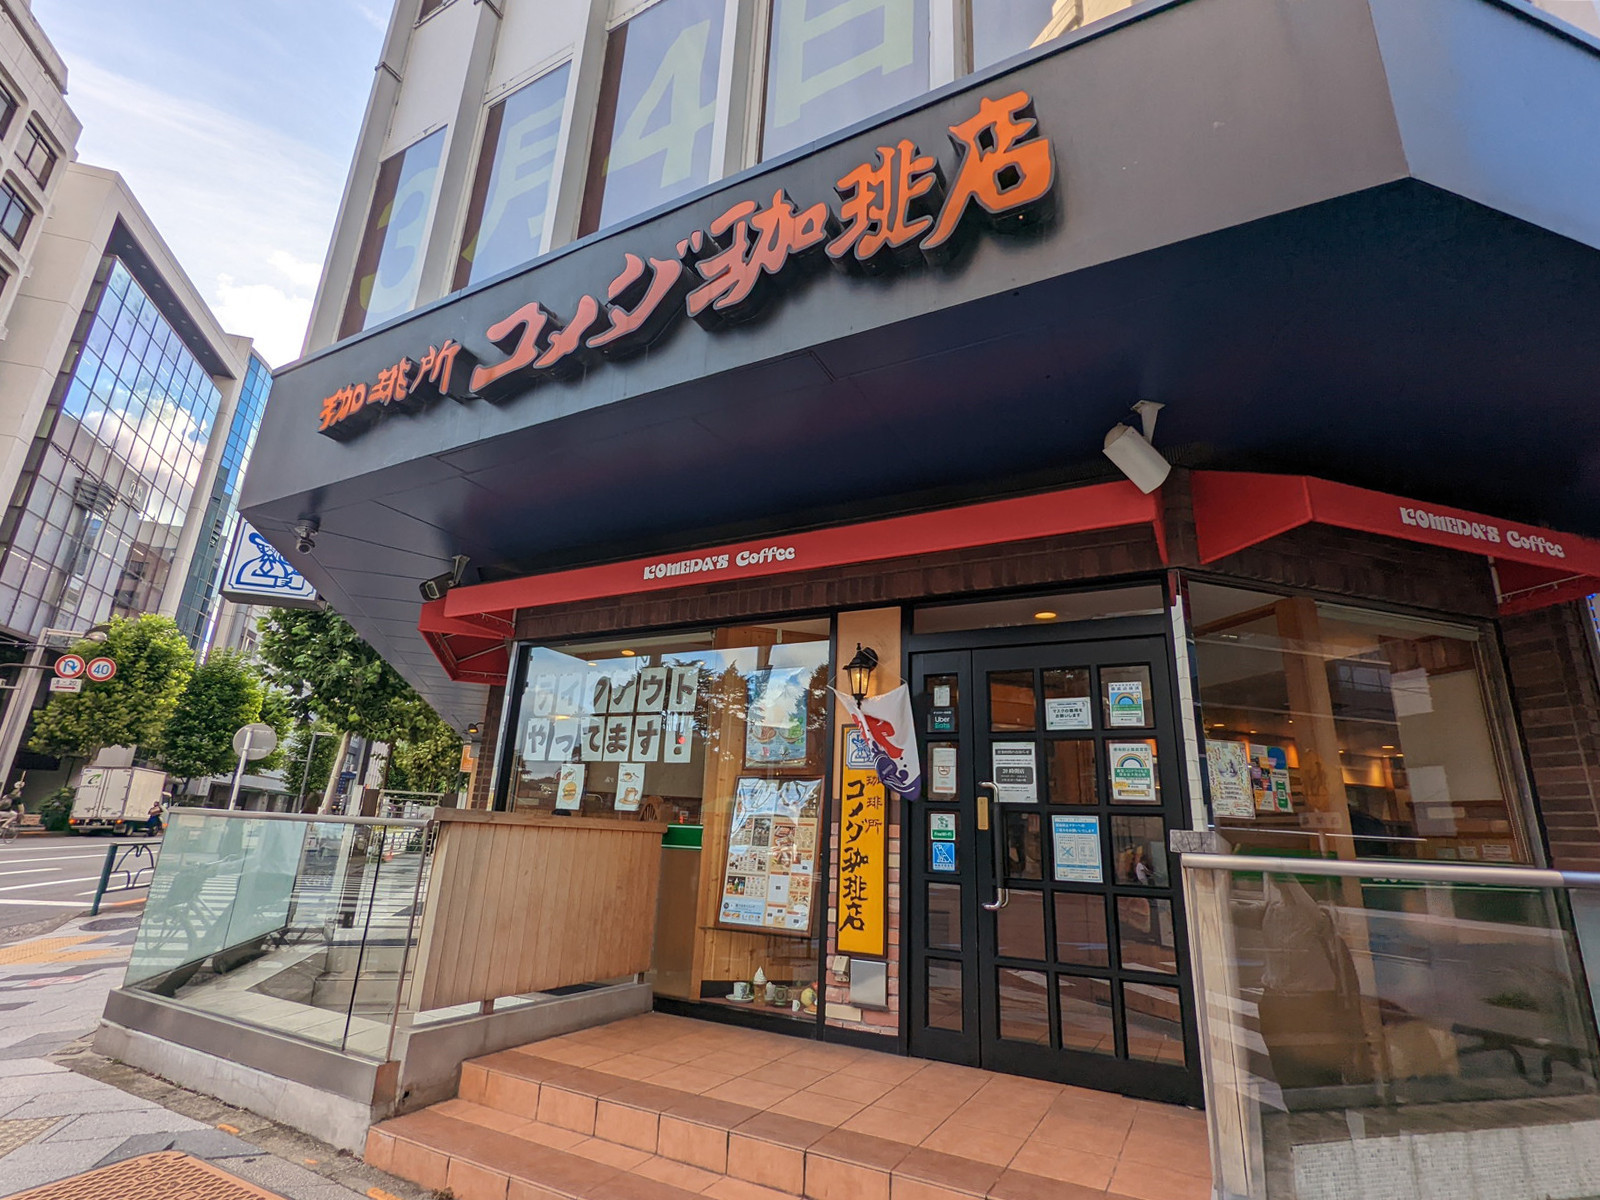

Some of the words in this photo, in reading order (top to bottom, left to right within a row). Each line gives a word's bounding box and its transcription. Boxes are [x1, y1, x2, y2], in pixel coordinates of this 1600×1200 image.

[318, 339, 463, 431] 珈琲所
[468, 90, 1054, 394] コメダ珈琲店
[1399, 506, 1501, 543] KOMEDA'S
[1506, 530, 1566, 559] Coffee
[643, 554, 729, 580] KOMEDA'S
[735, 546, 796, 567] Coffee
[93, 664, 110, 675] 40
[838, 779, 870, 933] コメダ珈琲店
